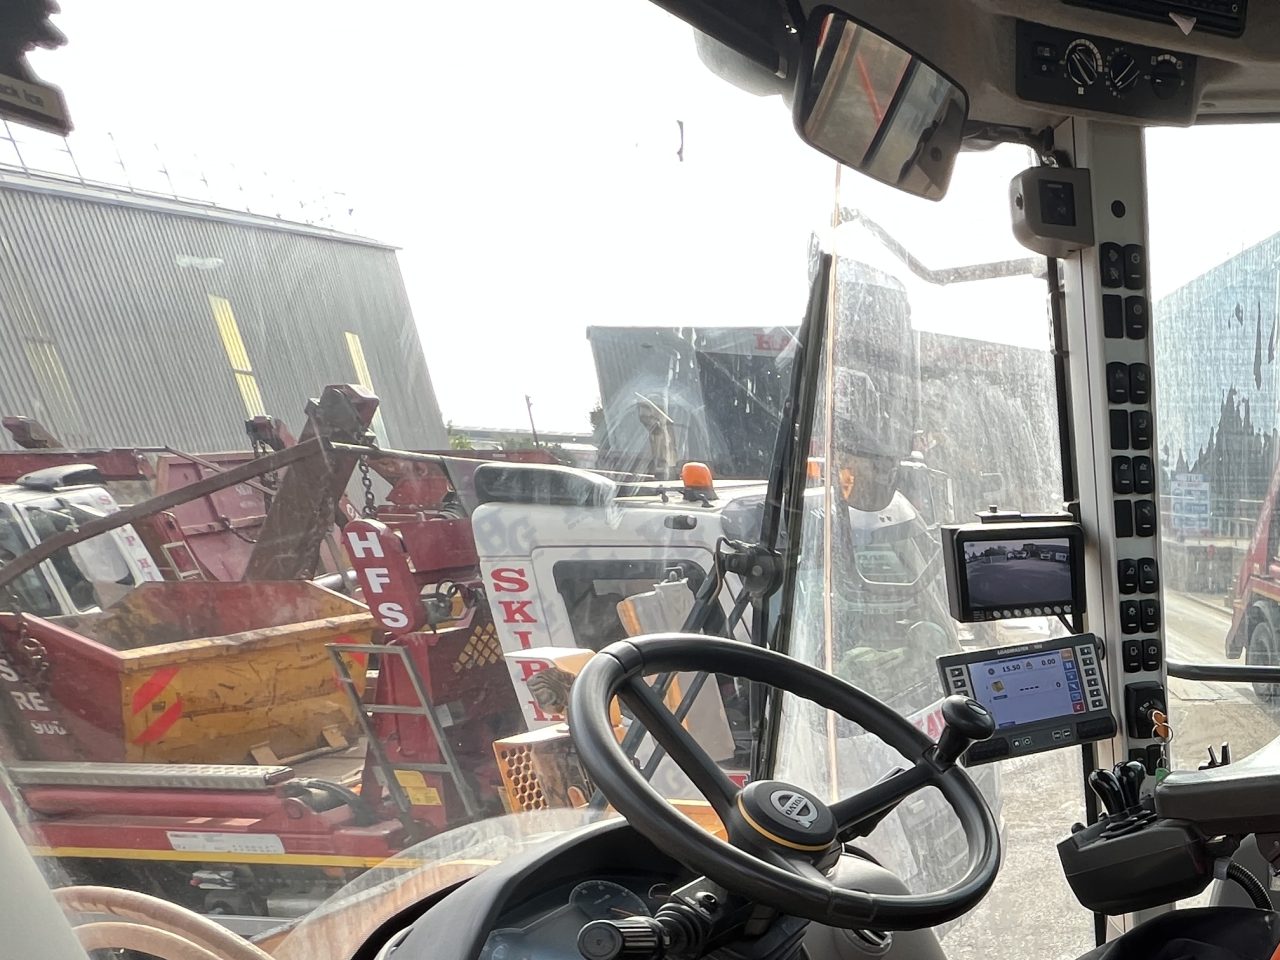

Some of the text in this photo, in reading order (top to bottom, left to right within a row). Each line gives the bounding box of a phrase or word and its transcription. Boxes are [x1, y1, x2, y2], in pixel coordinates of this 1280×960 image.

[346, 531, 409, 628] HFS
[1002, 664, 1021, 673] 15.50
[1041, 658, 1056, 666] 0.00
[785, 796, 805, 816] VOLVO
